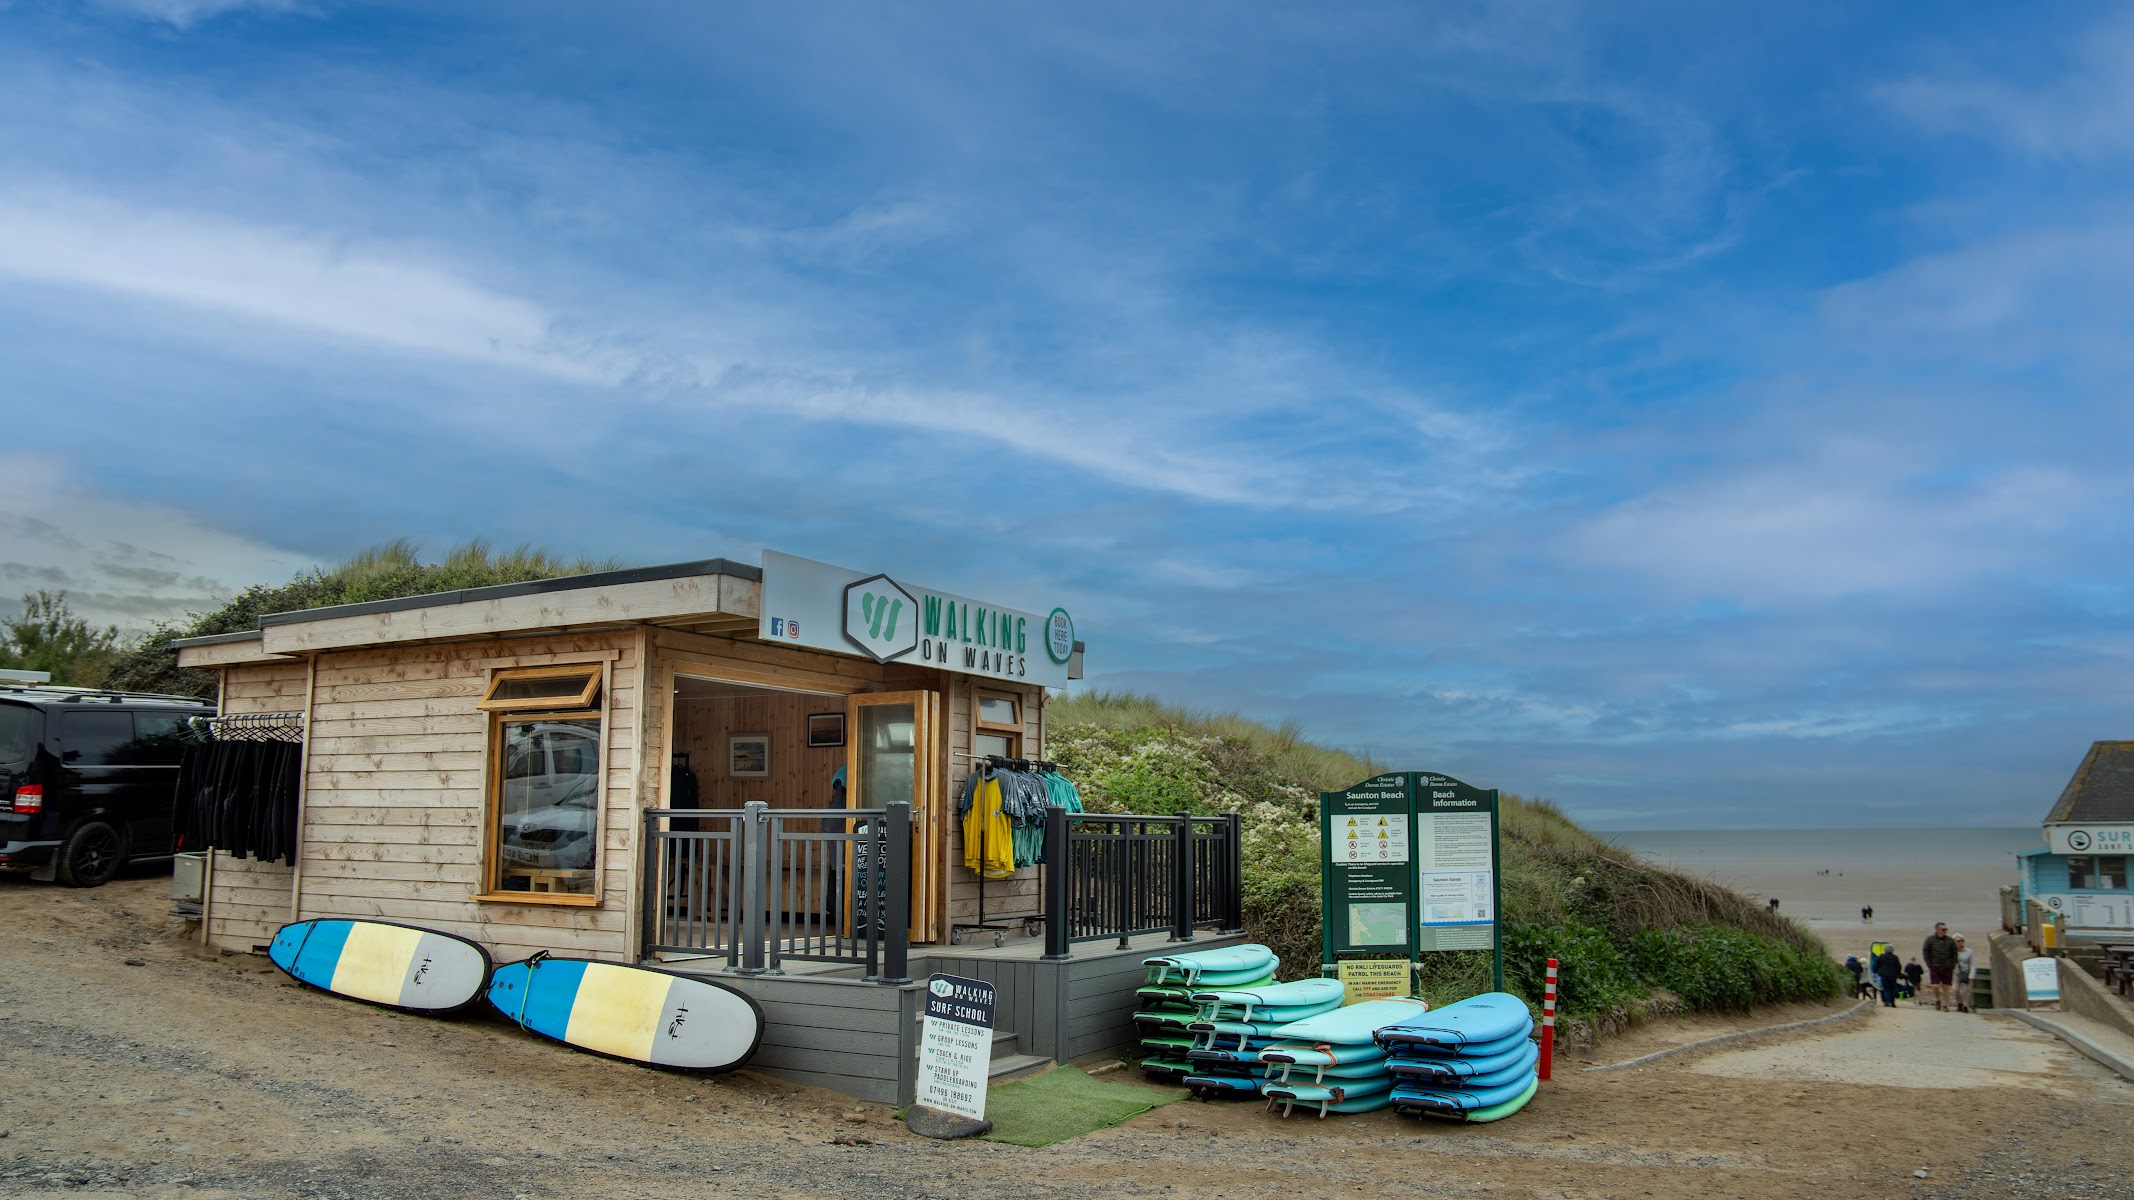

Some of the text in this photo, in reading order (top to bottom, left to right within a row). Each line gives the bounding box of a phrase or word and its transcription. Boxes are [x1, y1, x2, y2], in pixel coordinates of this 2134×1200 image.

[925, 594, 1026, 654] WALKING
[1055, 616, 1067, 629] BOOK
[1055, 629, 1067, 642] HERE
[1054, 642, 1068, 655] TODAY
[923, 638, 1026, 677] ON WAVES
[1381, 791, 1404, 799] Beach
[1432, 790, 1454, 798] Beach
[1433, 798, 1477, 807] information
[2097, 831, 2134, 842] SUR
[955, 984, 993, 1000] WALKING
[968, 996, 992, 1005] WAVES
[931, 1001, 987, 1022] SURF SCHOOL
[938, 1022, 960, 1032] PRIVATE
[961, 1026, 984, 1037] LESSONS
[938, 1035, 953, 1044] GROUP
[955, 1039, 978, 1050] LESSONS
[936, 1048, 952, 1059] COACH
[960, 1054, 972, 1063] RIDE
[934, 1066, 951, 1075] STAND
[934, 1073, 978, 1089] PADDLEBOARDING
